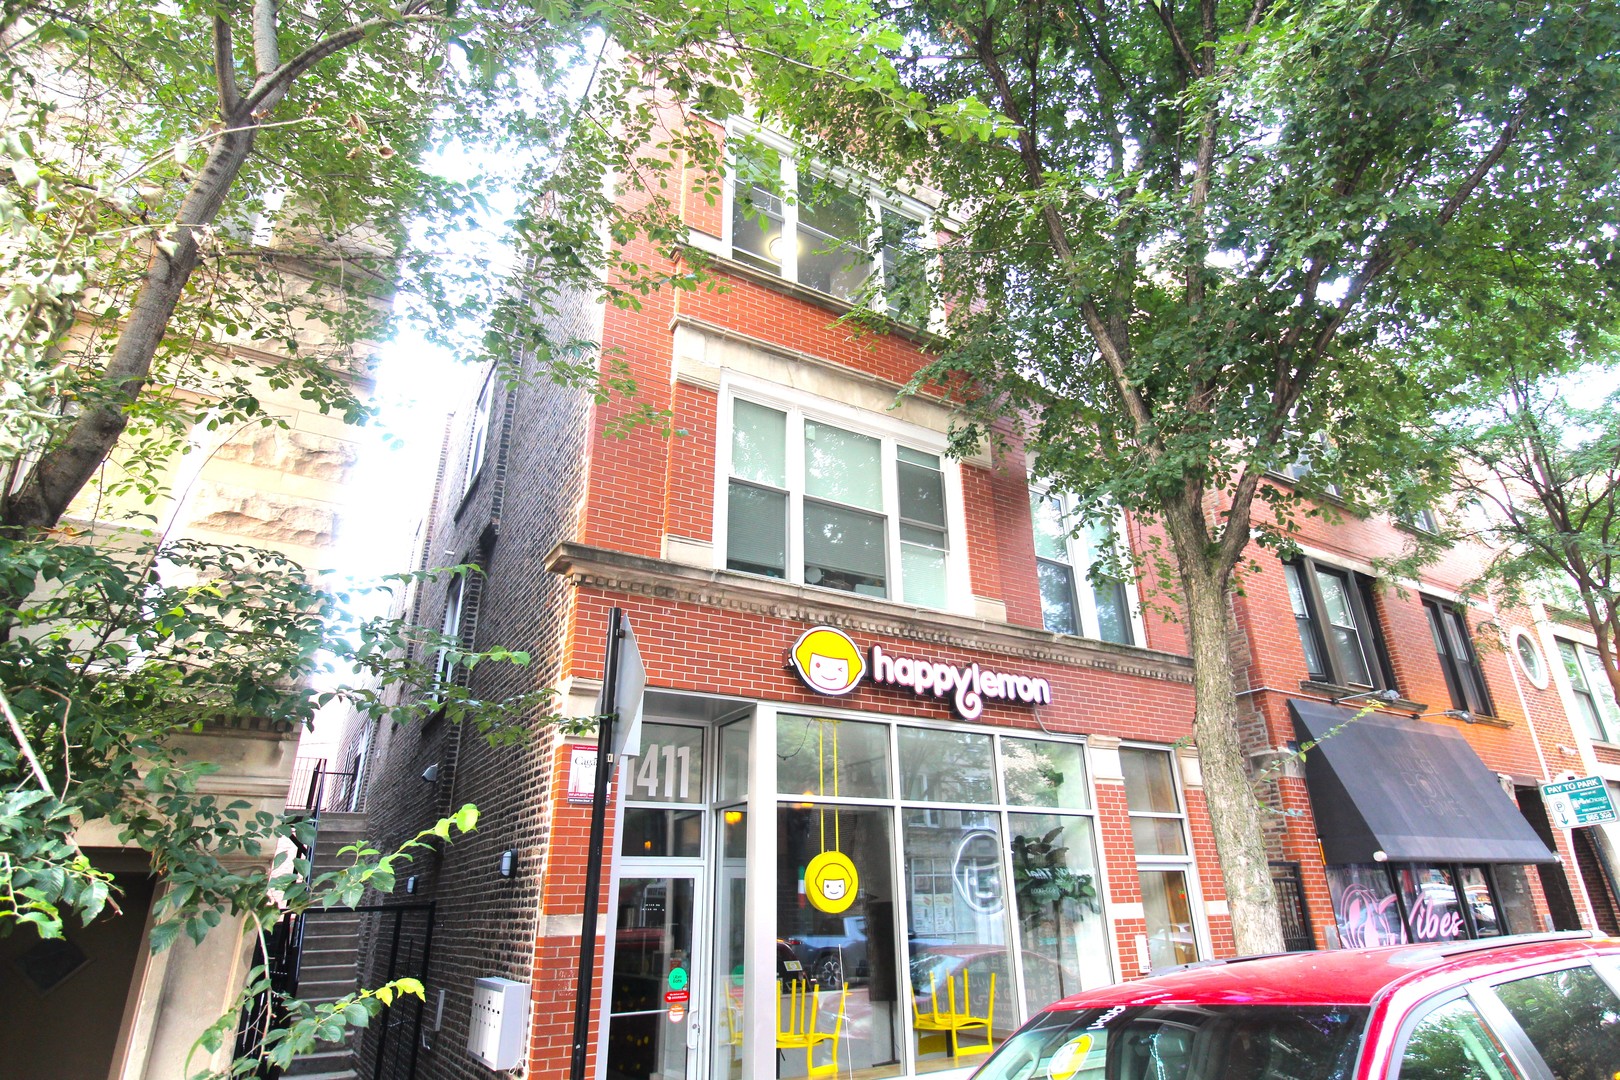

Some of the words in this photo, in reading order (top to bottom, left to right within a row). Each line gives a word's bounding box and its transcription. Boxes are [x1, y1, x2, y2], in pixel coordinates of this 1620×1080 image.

[626, 743, 690, 798] 1411
[1547, 785, 1562, 794] PAY
[1564, 783, 1576, 791] TO
[1577, 779, 1599, 788] PARK
